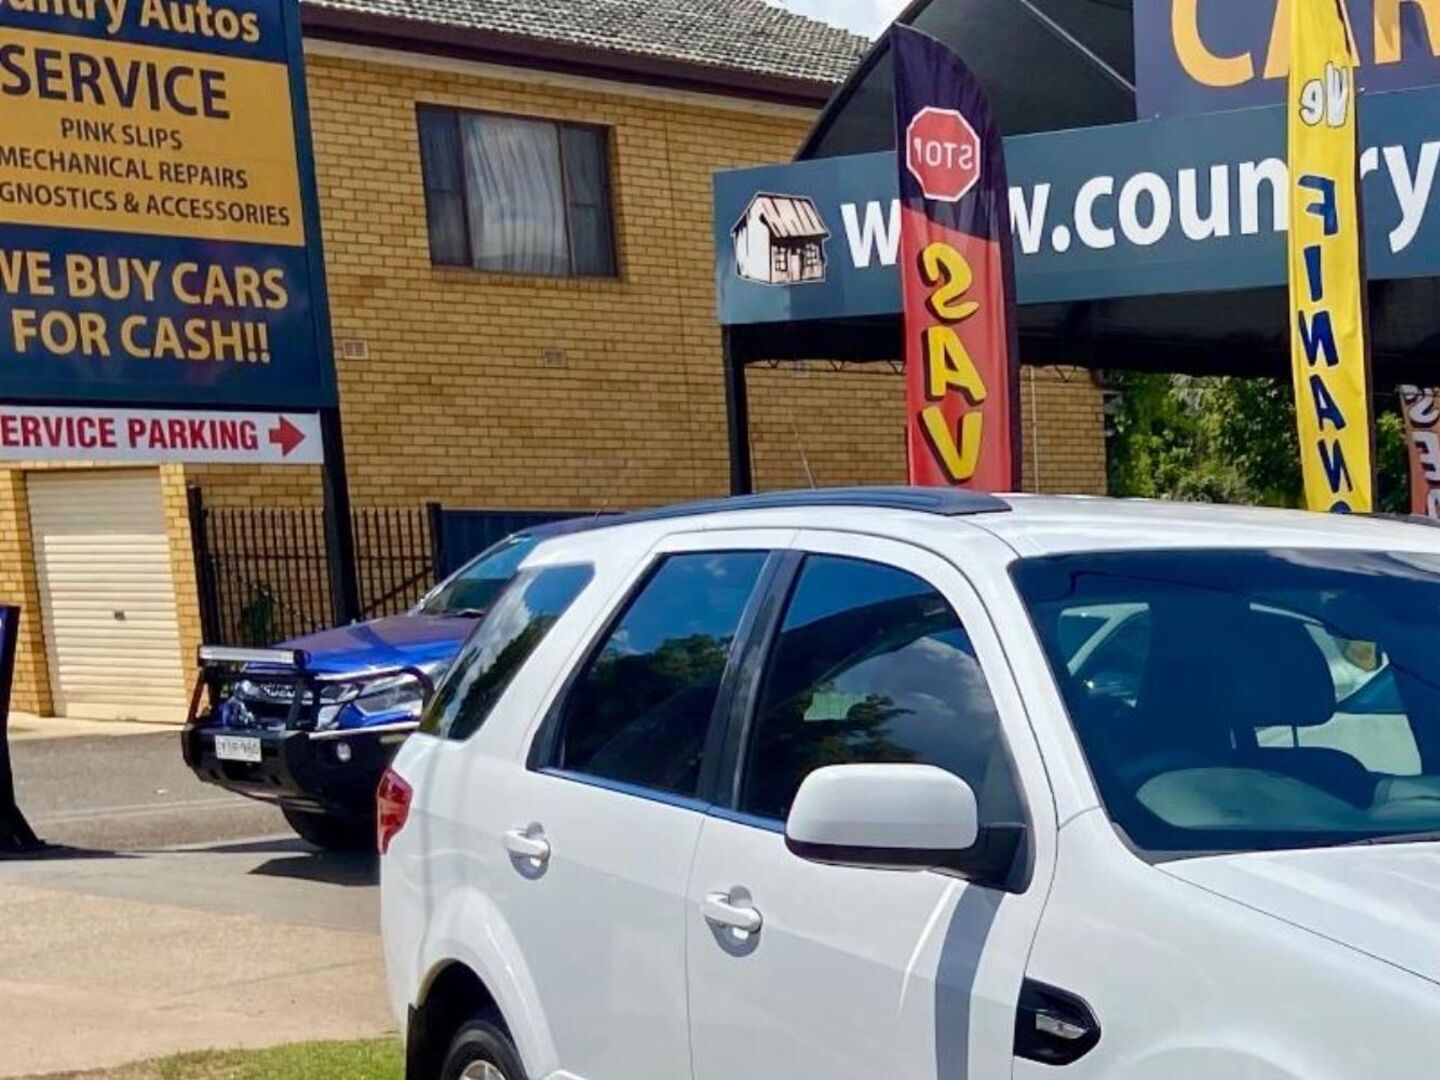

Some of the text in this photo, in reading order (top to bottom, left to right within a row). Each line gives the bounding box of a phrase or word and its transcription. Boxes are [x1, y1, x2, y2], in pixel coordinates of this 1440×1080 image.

[140, 0, 261, 42] Autos
[0, 43, 231, 119] SERVICE
[60, 117, 183, 150] PINK SLIPS
[0, 145, 249, 190] MECHANICAL REPAIRS
[123, 192, 140, 214] &
[146, 194, 291, 227] ACCESSORIES
[66, 255, 161, 301] BUY
[172, 262, 289, 310] CARS
[12, 308, 271, 364] FOR CASH!!
[0, 415, 259, 451] ERVICE PARKING
